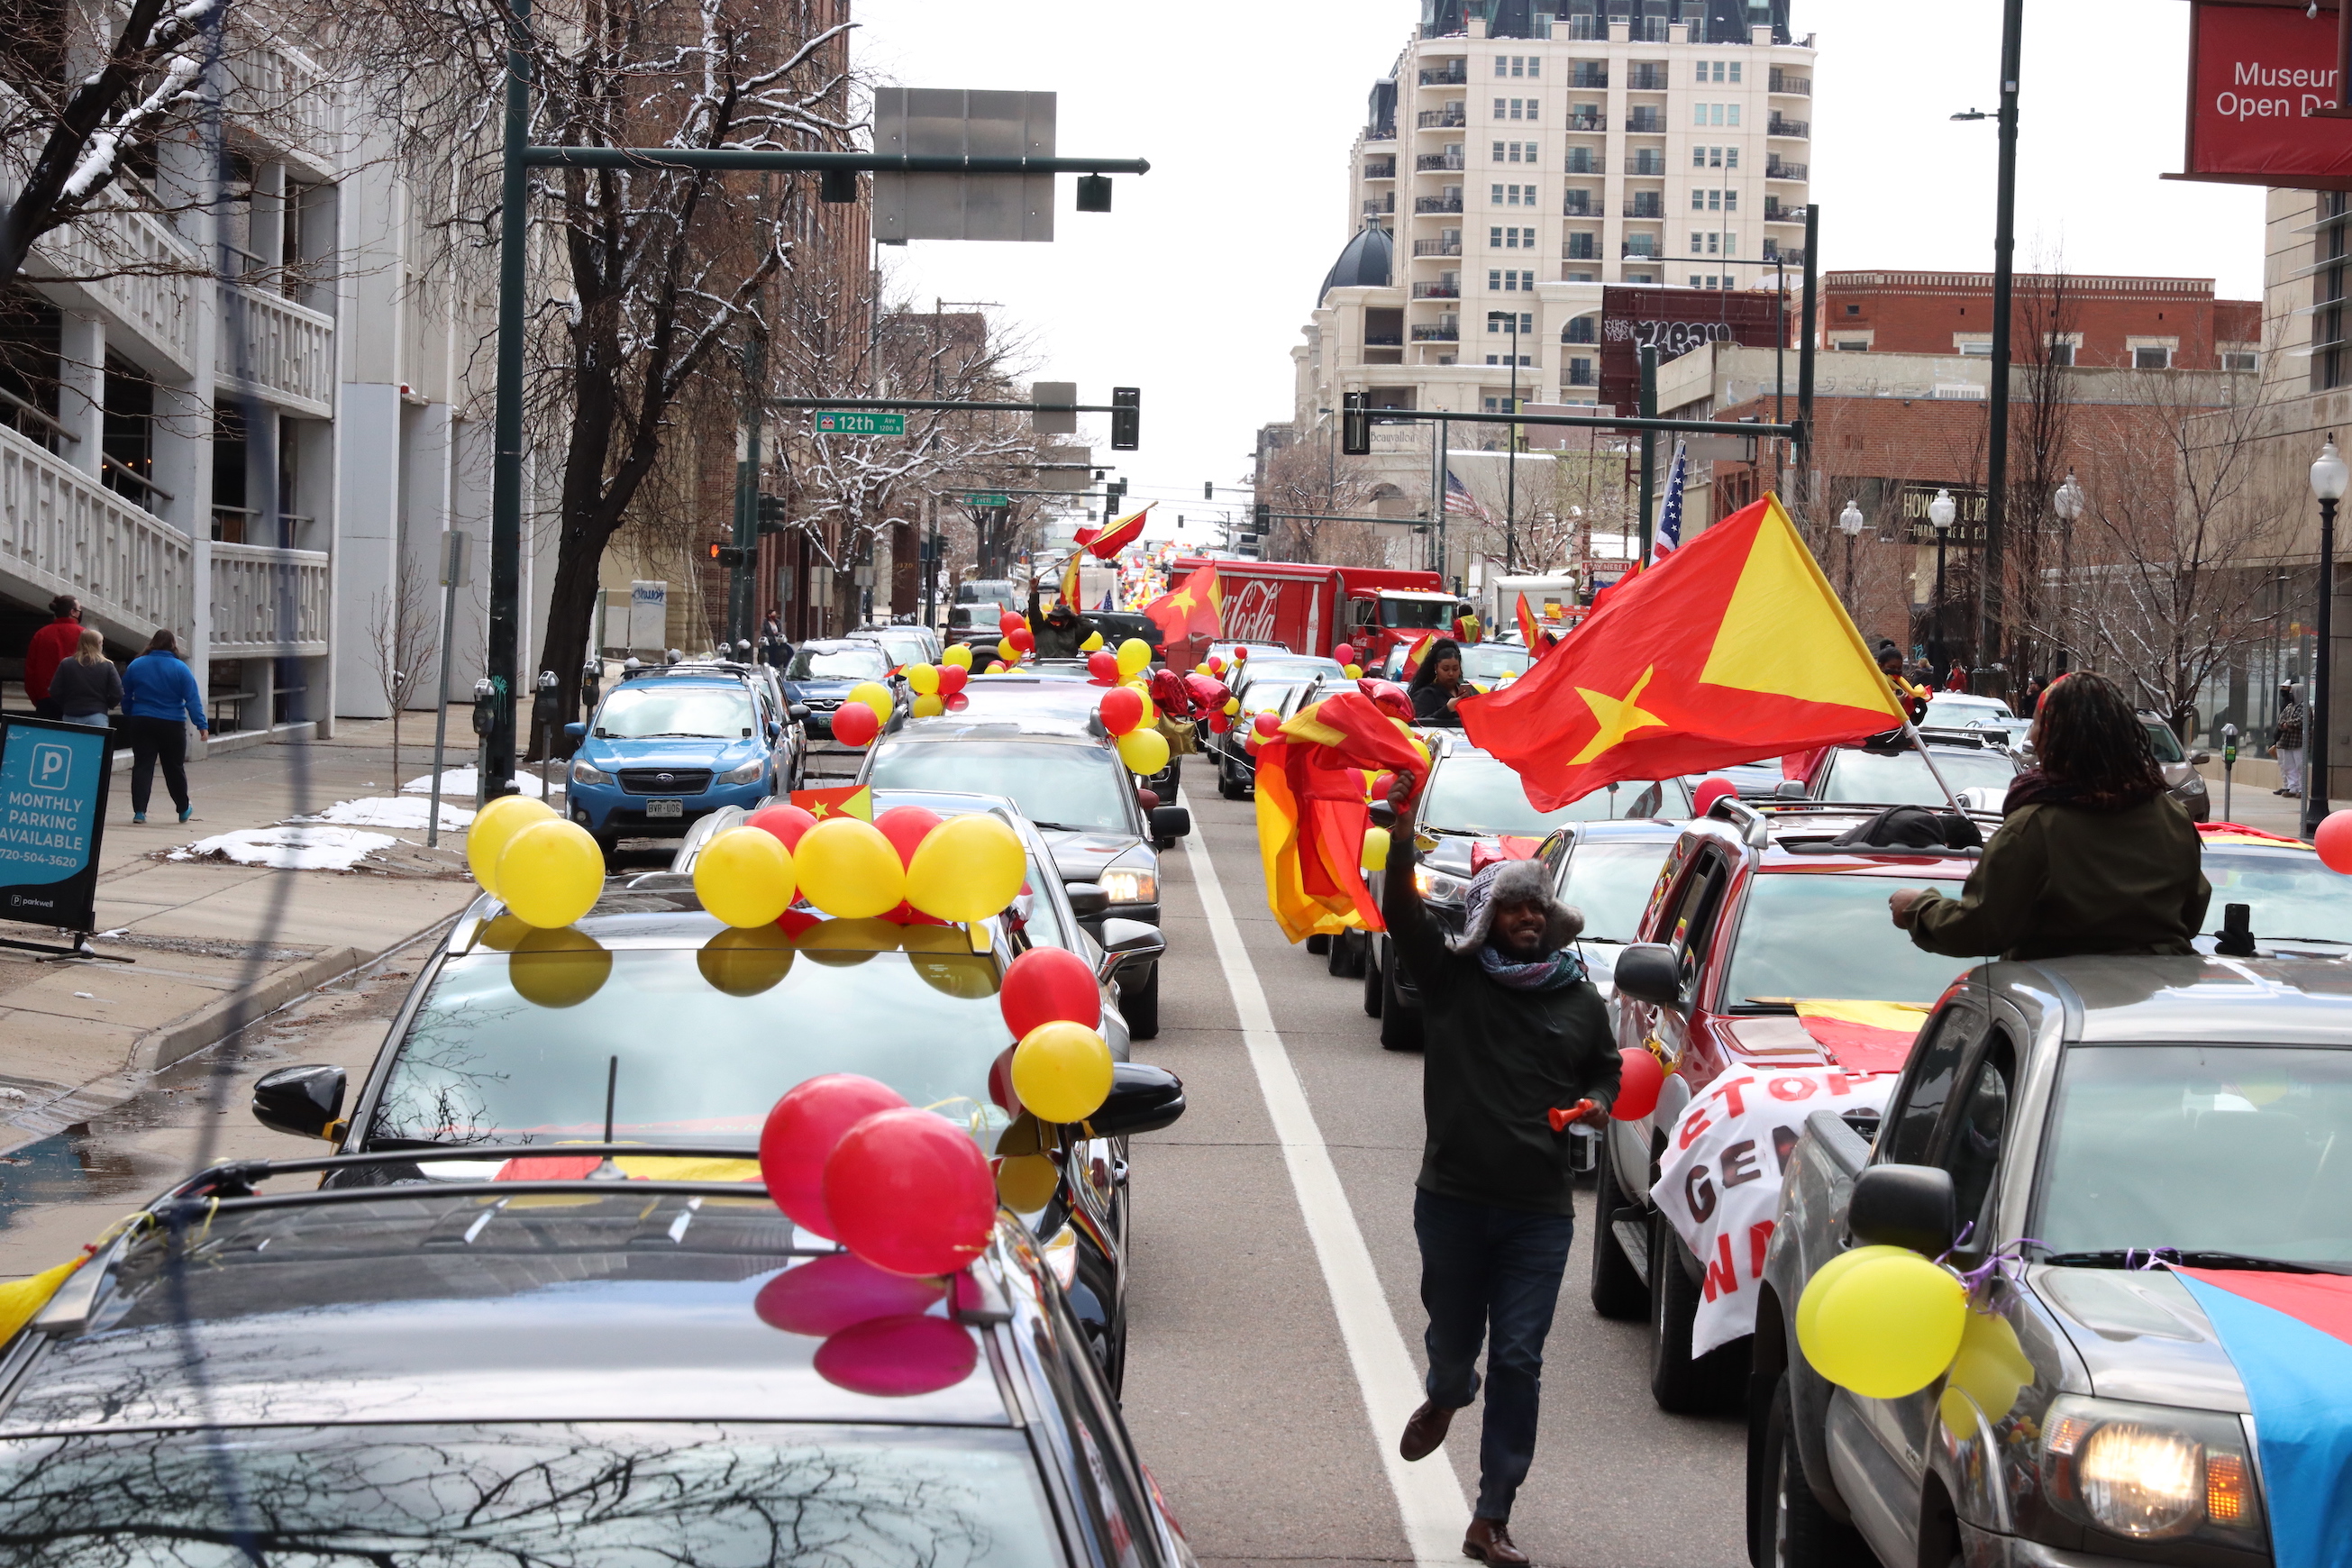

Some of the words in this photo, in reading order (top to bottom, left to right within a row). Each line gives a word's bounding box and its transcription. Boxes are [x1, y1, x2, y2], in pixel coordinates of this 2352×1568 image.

[2216, 91, 2290, 122] Open
[839, 416, 874, 431] 12th
[1371, 432, 1415, 442] Beauvallon
[9, 791, 83, 813] MONTHLY
[9, 809, 77, 831] PARKING
[0, 827, 83, 851] AVAILABLE
[0, 848, 77, 868] 720-504-3620
[23, 898, 53, 907] parkwell
